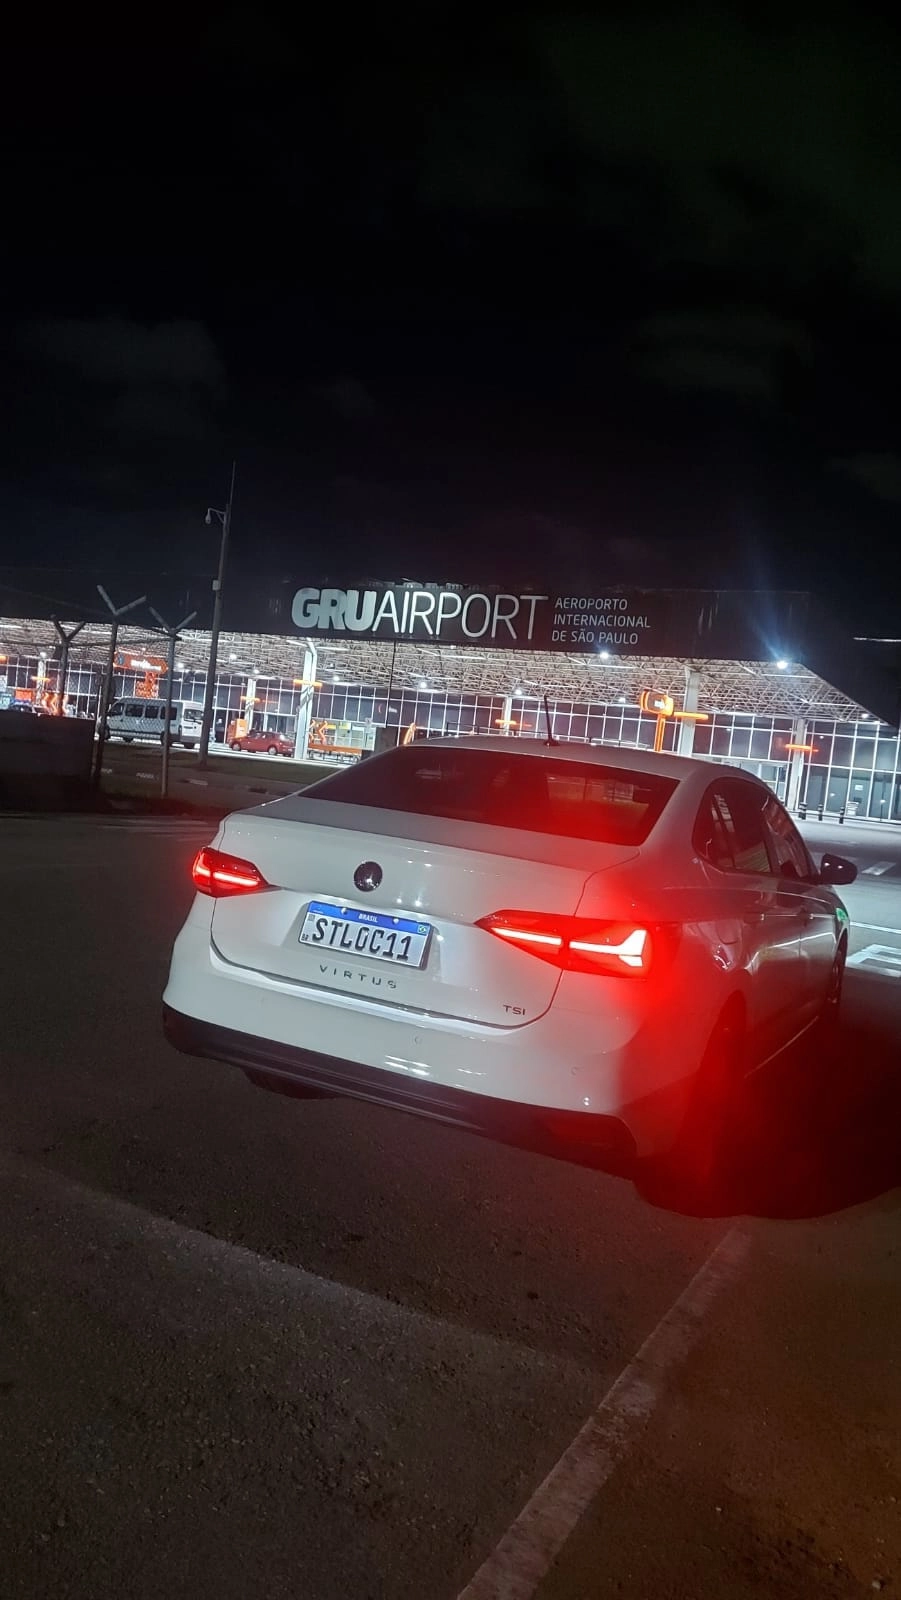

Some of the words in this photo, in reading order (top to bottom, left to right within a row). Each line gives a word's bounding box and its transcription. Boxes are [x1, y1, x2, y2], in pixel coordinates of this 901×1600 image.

[554, 597, 628, 611] AEROPORTO
[553, 614, 651, 628] INTERNACIONAL
[551, 630, 567, 642] DE
[571, 628, 595, 643] SÃO
[598, 632, 639, 645] PAULO
[358, 913, 378, 923] BRASIL
[319, 964, 397, 989] VIRTUS
[503, 1004, 526, 1016] TSI
